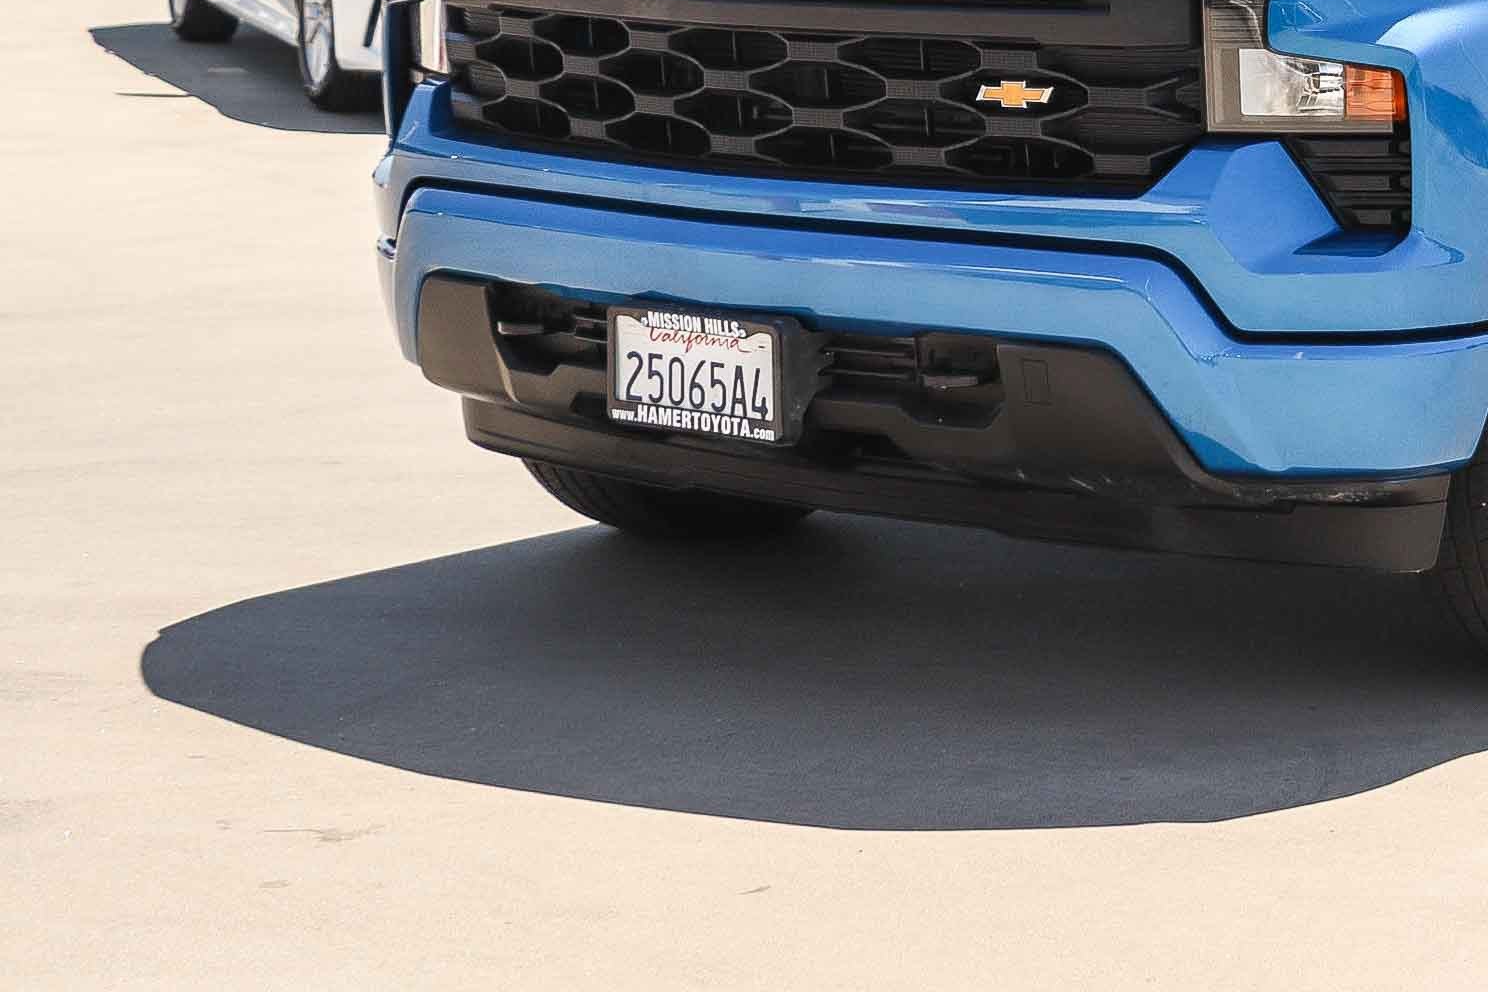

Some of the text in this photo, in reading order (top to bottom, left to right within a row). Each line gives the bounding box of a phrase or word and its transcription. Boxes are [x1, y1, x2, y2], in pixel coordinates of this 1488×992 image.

[647, 310, 740, 338] MISSION HILLS
[650, 326, 752, 354] California
[625, 350, 769, 418] 25065A4
[612, 404, 775, 442] www.HAMERTOYOTA.com
